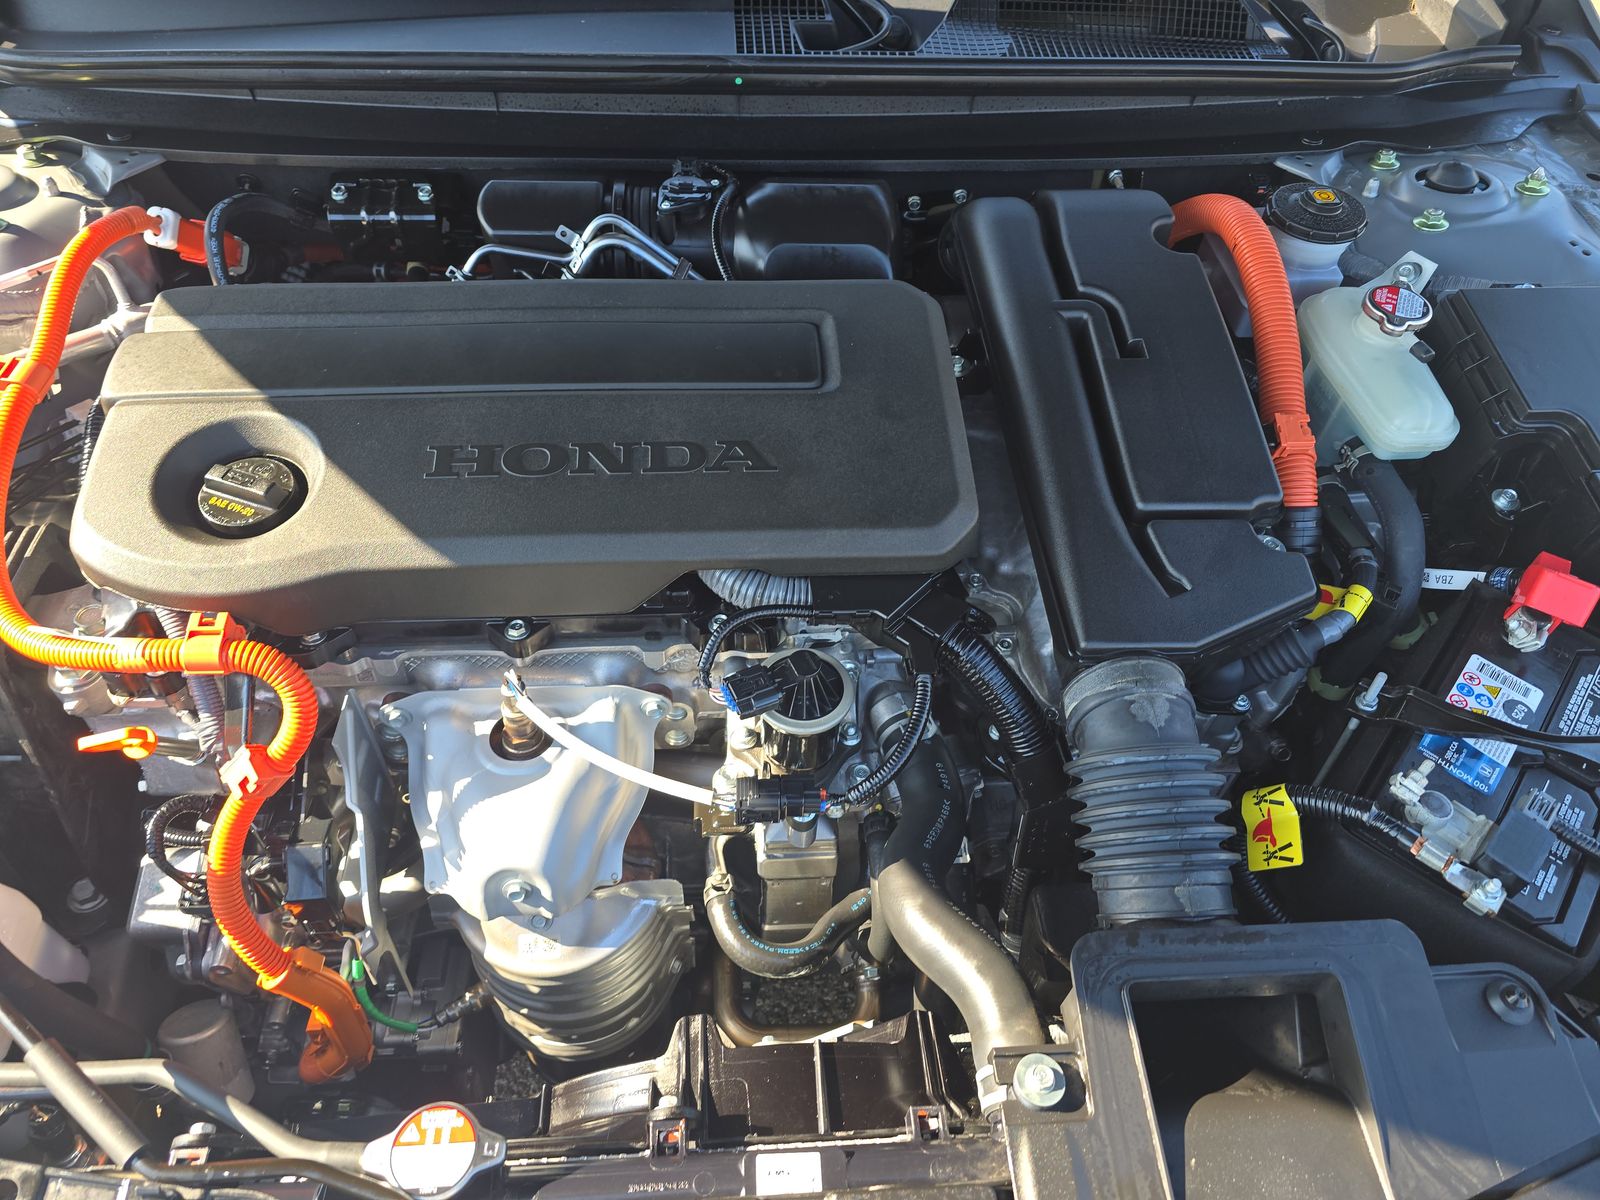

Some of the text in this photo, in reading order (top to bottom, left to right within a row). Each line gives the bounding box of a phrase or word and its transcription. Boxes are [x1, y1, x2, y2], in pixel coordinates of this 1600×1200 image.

[423, 440, 779, 479] HONDA
[208, 496, 255, 517] SAE 0W-20
[1435, 574, 1454, 585] ZBA
[1512, 704, 1528, 721] 6/25
[1437, 758, 1489, 793] 100 MONTH
